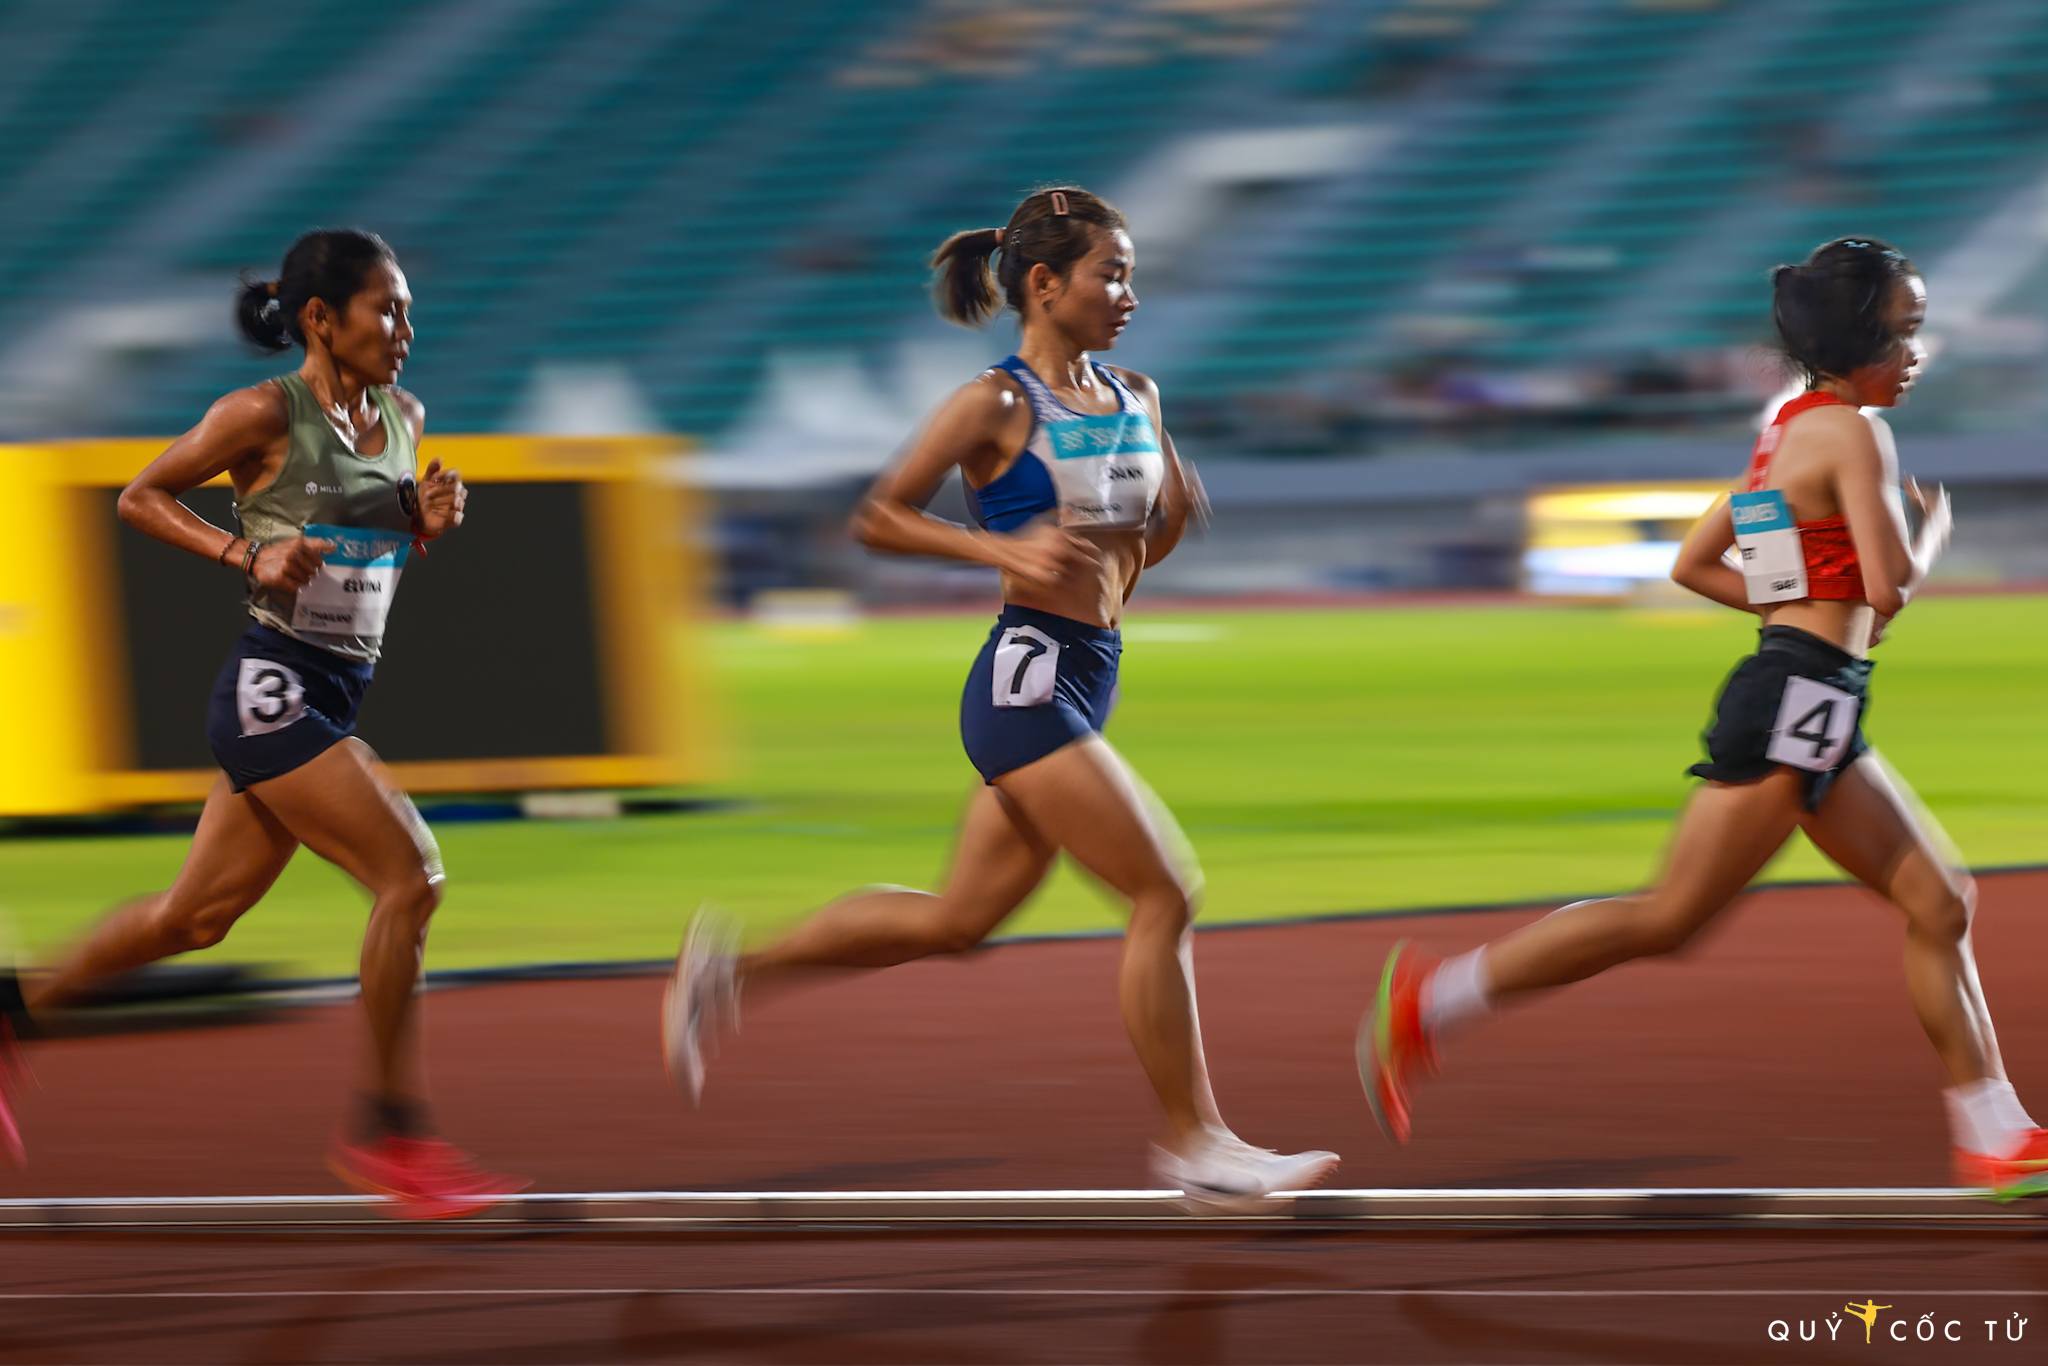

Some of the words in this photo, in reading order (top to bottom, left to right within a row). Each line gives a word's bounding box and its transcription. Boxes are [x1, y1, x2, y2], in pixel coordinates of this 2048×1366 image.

[1009, 635, 1048, 694] 7
[250, 668, 288, 723] 3
[1786, 699, 1837, 759] 4
